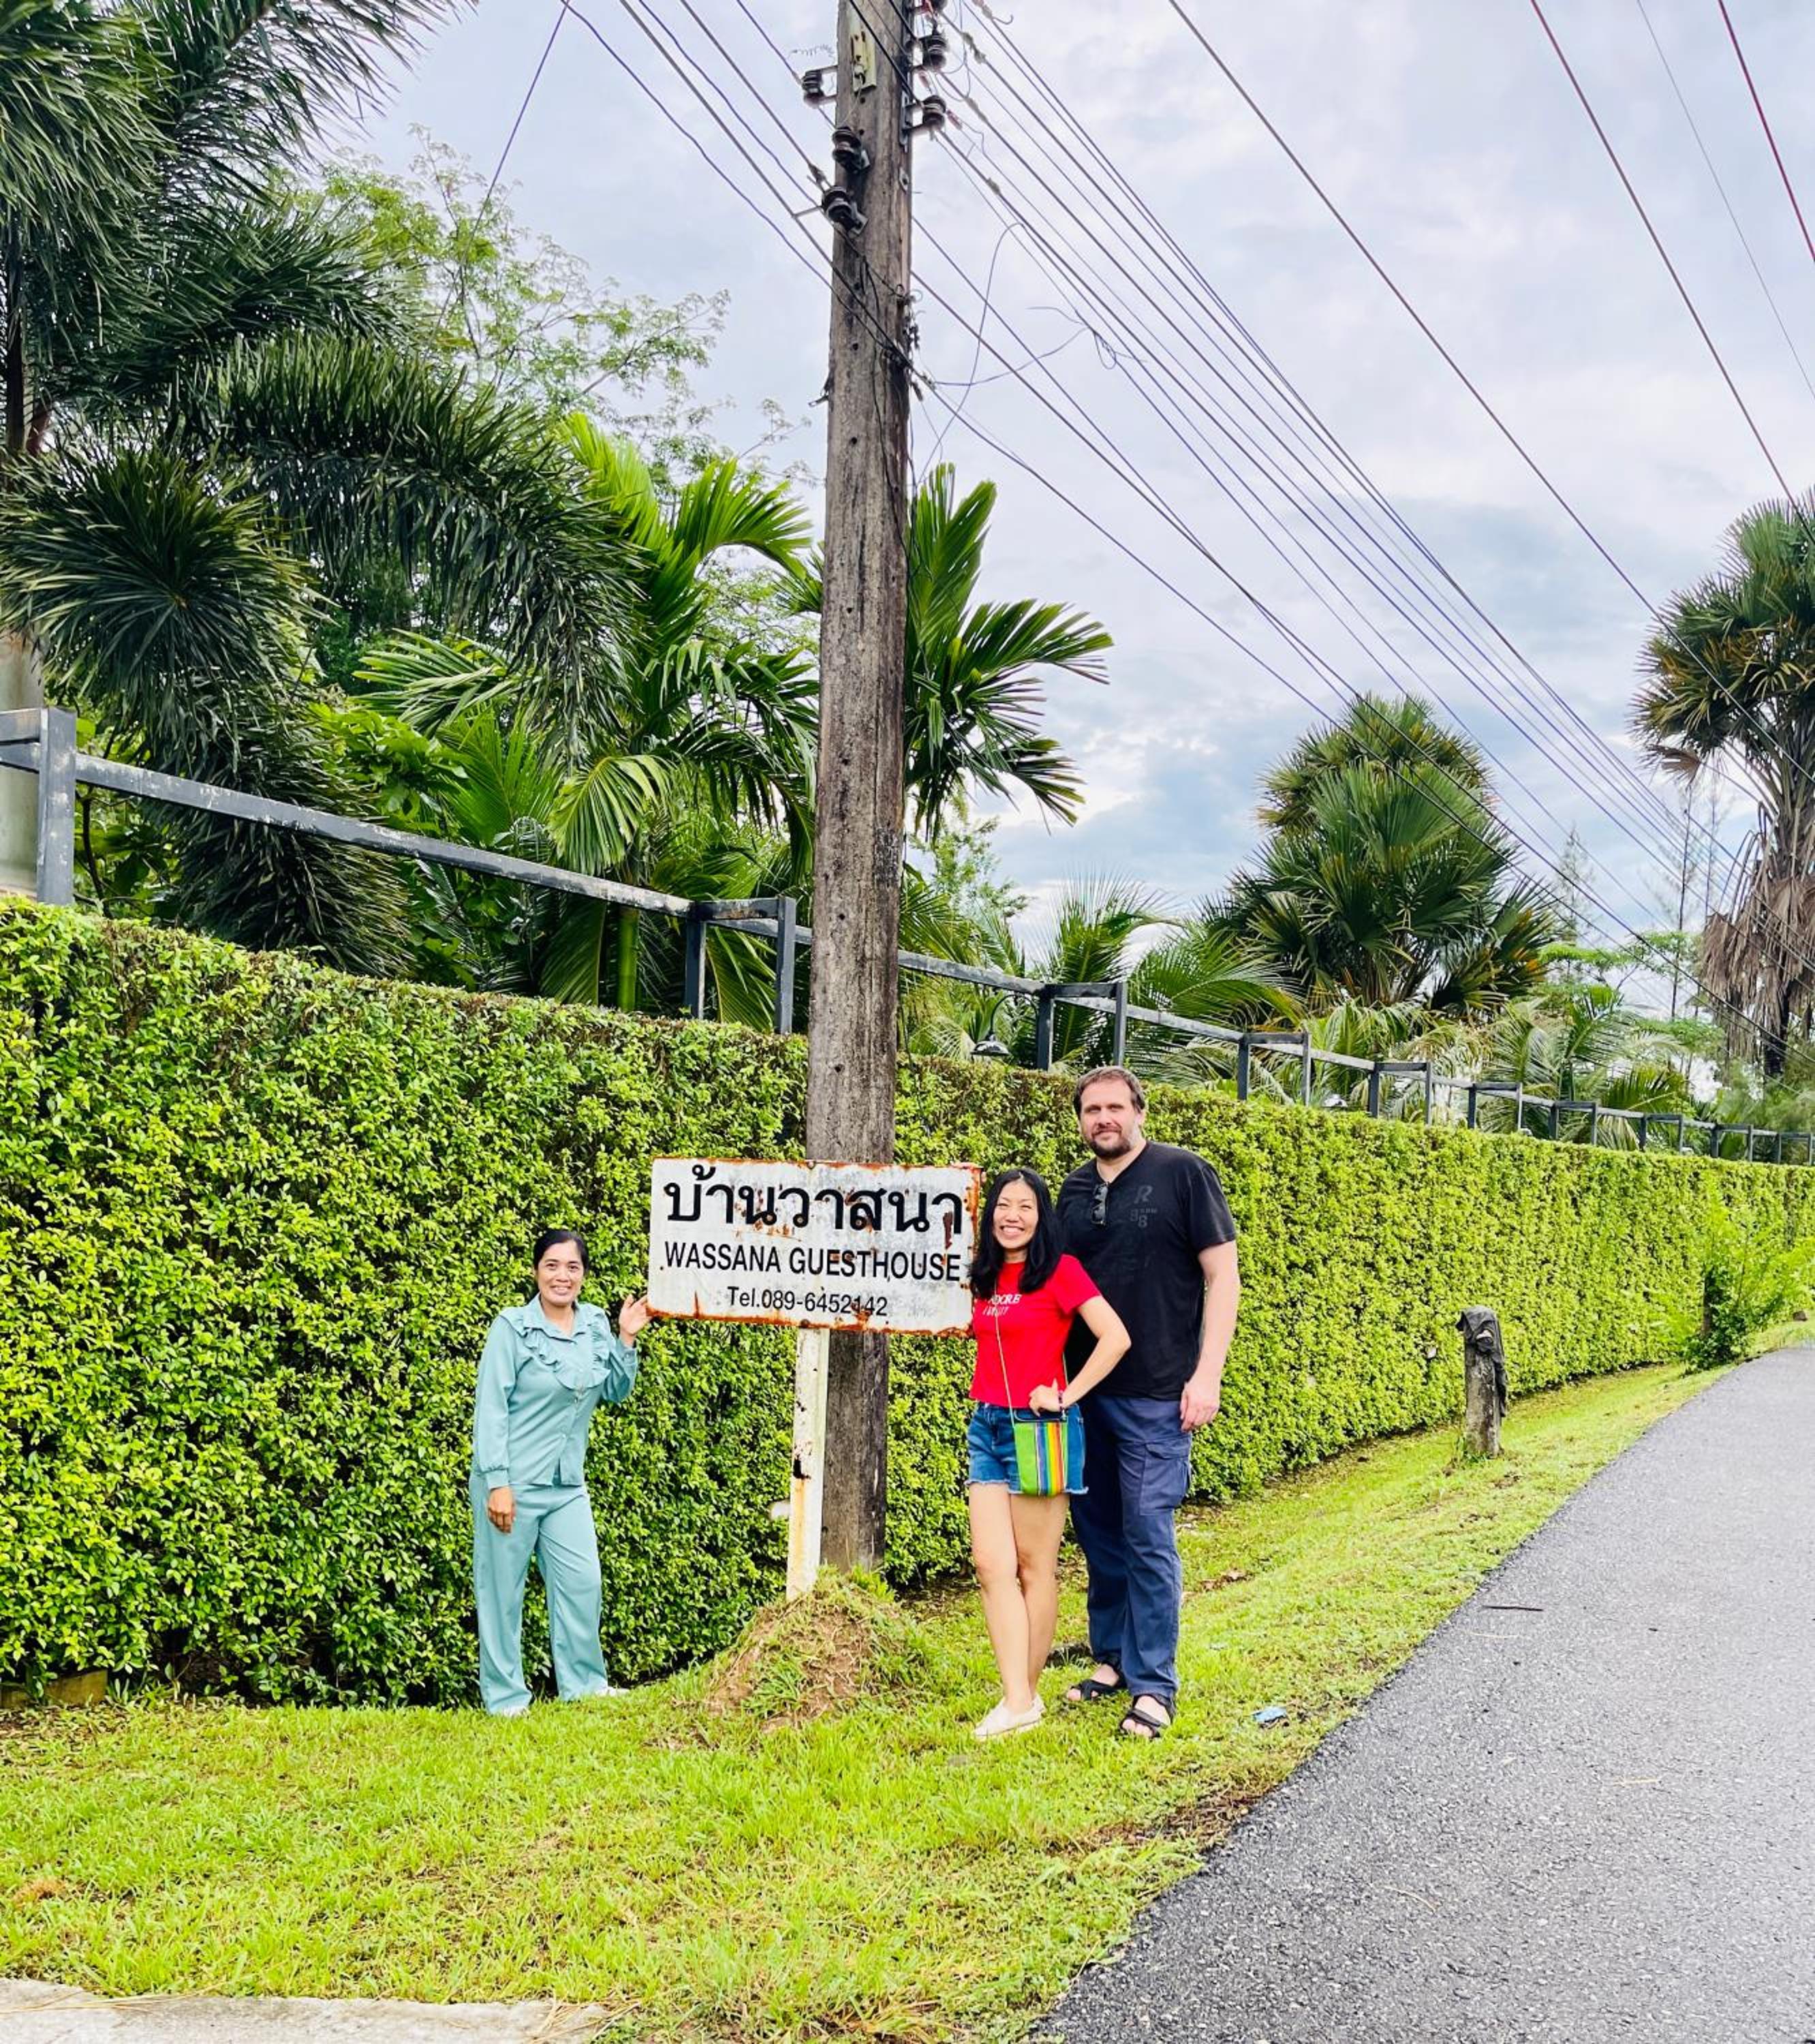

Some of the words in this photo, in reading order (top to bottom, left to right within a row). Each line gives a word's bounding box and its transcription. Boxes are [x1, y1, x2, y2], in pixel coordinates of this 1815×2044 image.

[664, 1164, 963, 1235] บ้านวาสนา
[664, 1241, 781, 1273] WASSANA
[789, 1247, 961, 1282] GUESTHOUSE
[727, 1286, 888, 1316] Tel.089-6452142
